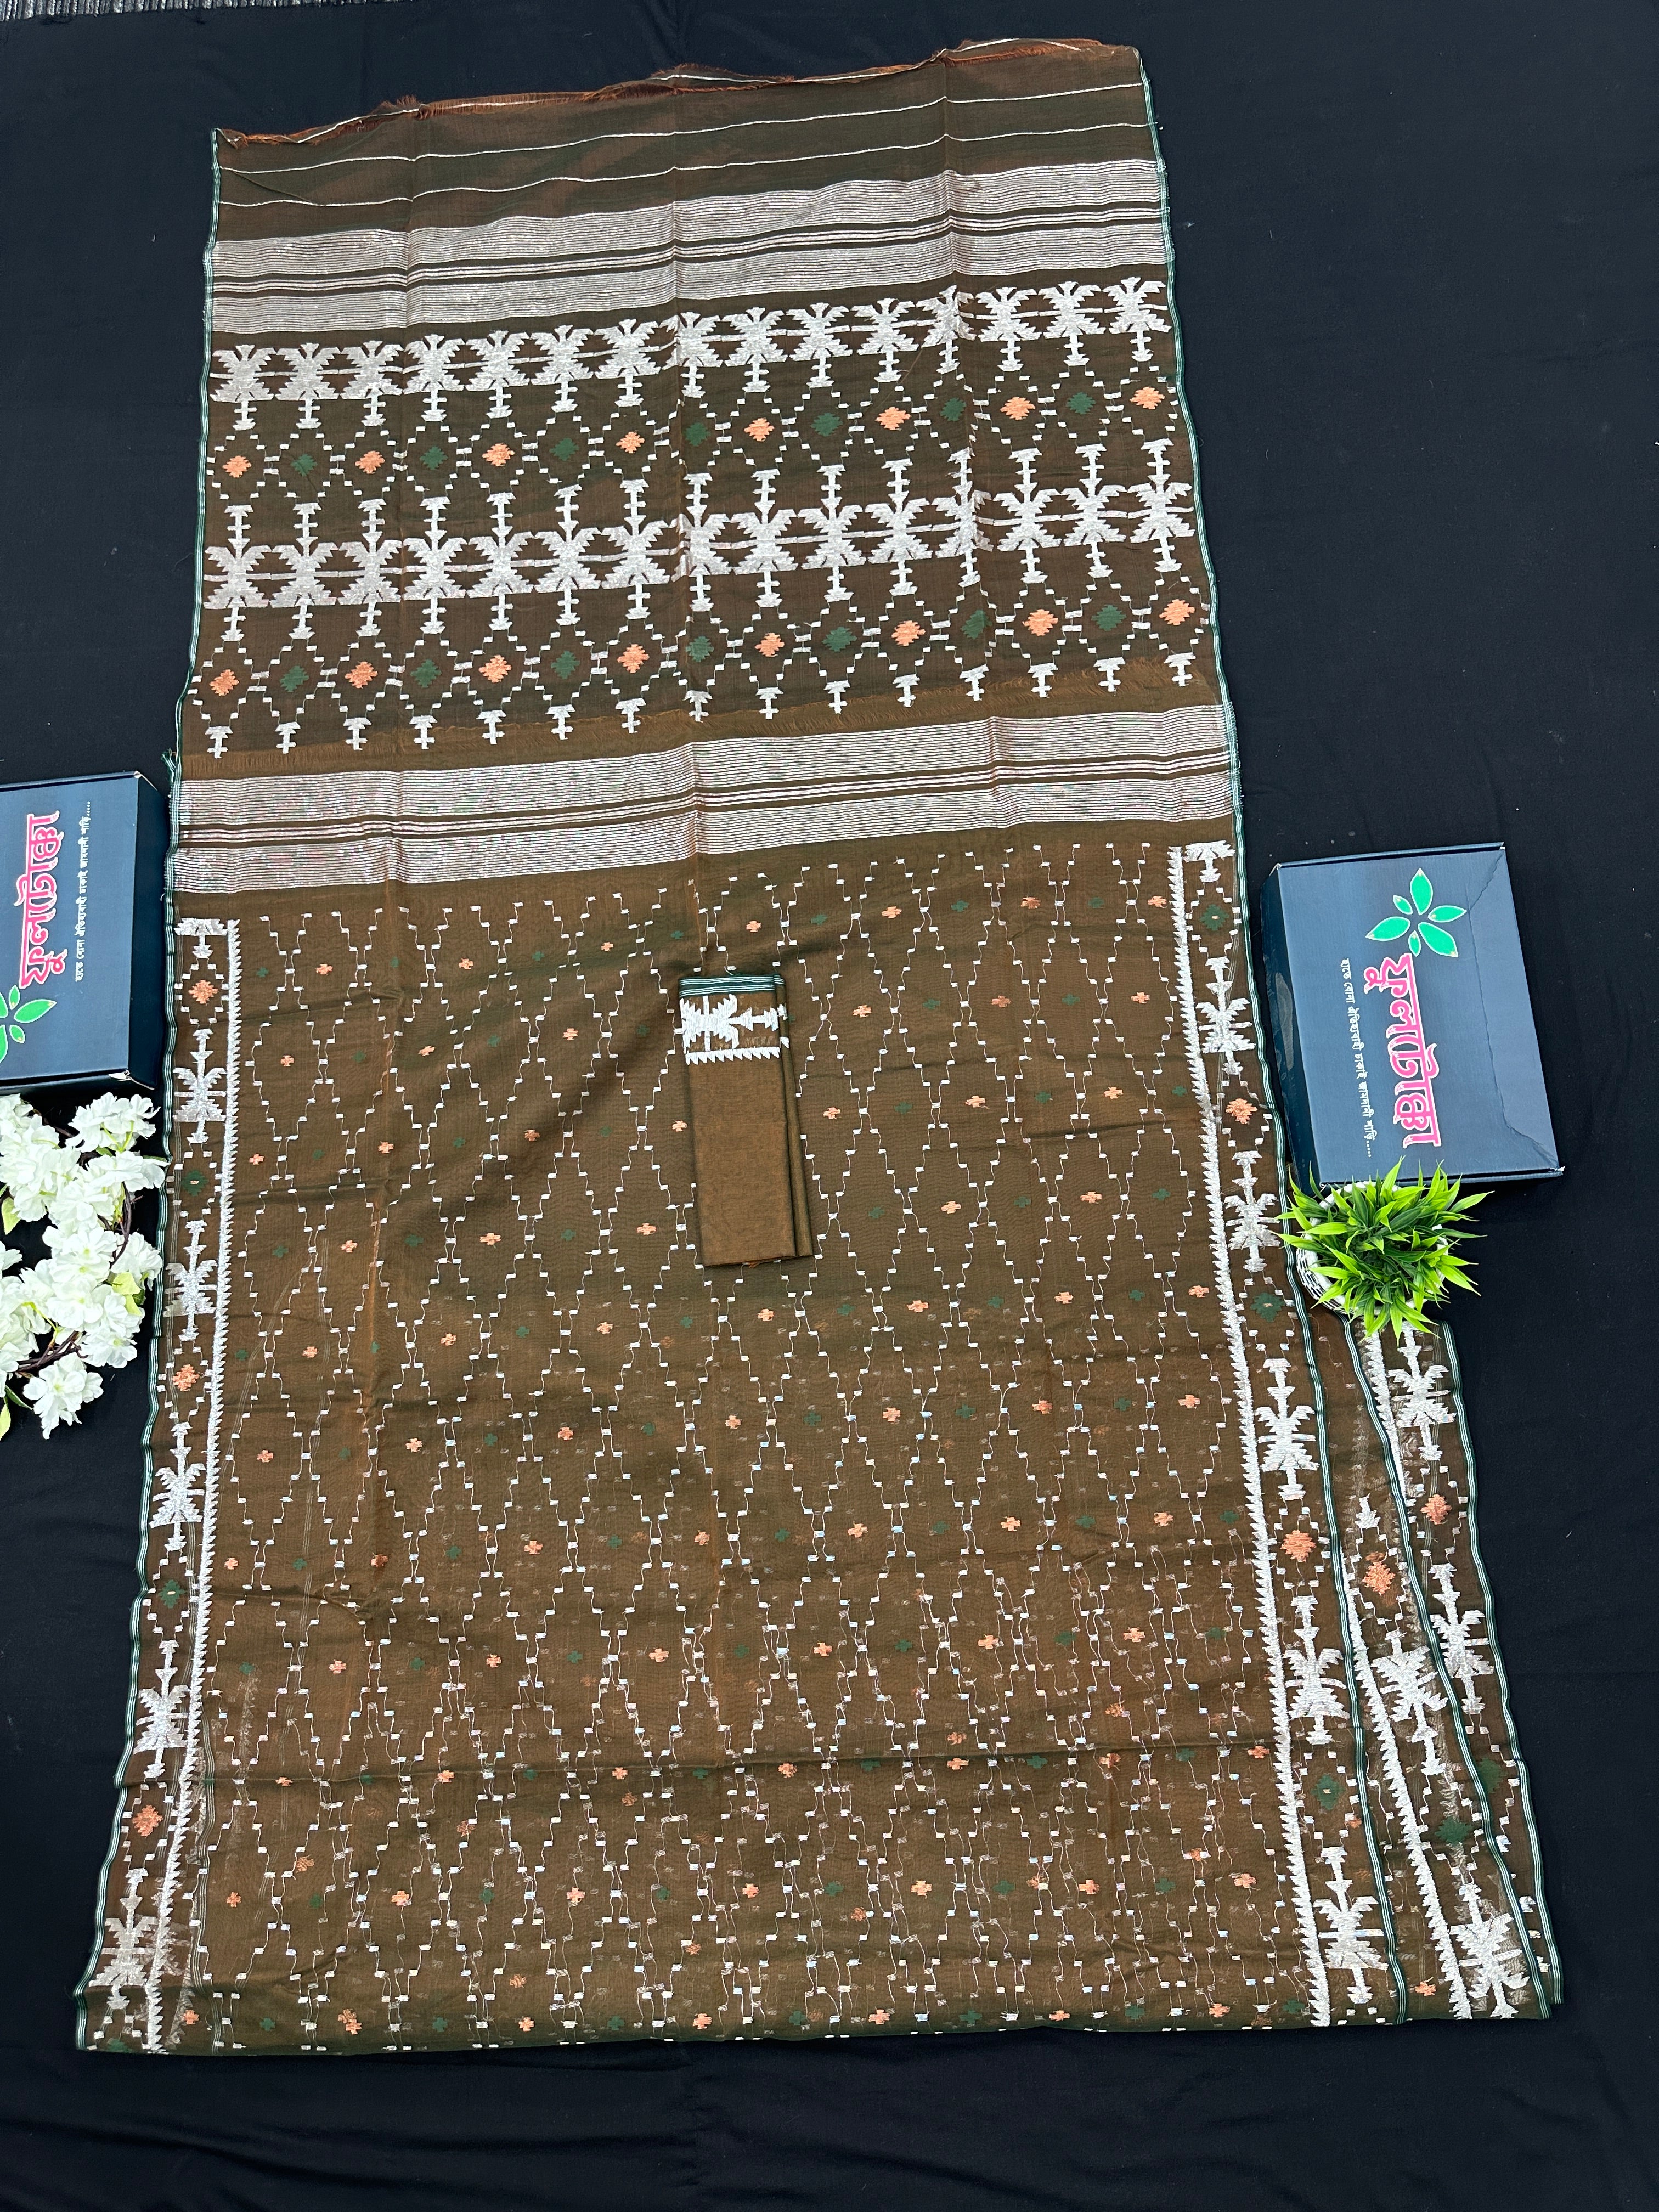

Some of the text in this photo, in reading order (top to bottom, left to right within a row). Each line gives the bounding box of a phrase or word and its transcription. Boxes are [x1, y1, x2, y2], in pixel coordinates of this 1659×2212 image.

[77, 870, 88, 895] ঢাকাই
[14, 810, 68, 989] ফুলটোক্কা
[75, 939, 86, 960] বোনা
[75, 961, 84, 983] হাতে
[1340, 958, 1352, 980] হাতে
[1343, 981, 1356, 1004] বোনা
[1363, 952, 1442, 1148] ফুলটোক্কা
[1354, 1052, 1368, 1080] ঢাকাই
